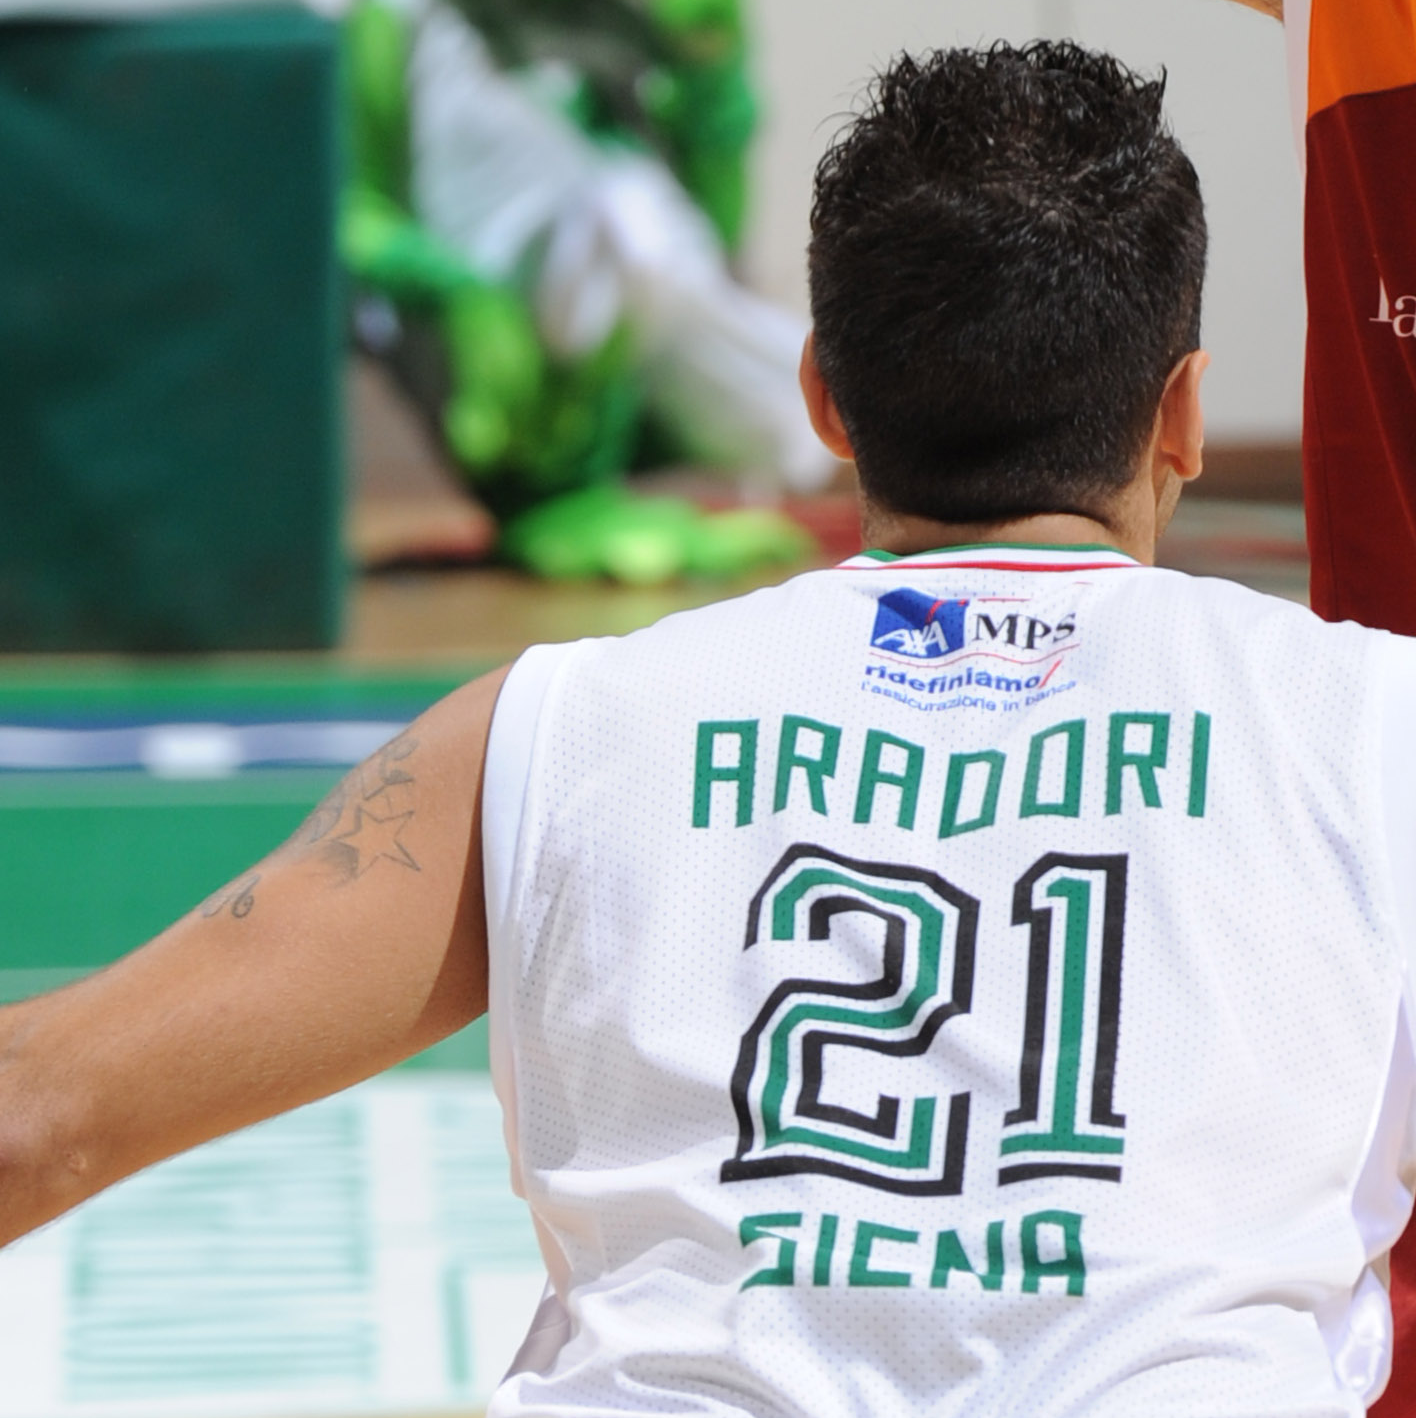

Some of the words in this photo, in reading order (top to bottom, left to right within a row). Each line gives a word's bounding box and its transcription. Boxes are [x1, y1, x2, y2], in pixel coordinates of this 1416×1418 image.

[873, 619, 950, 658] AXA
[970, 611, 1077, 651] MPS
[860, 679, 997, 712] l'assicurazione
[1002, 699, 1020, 713] in
[1024, 678, 1077, 707] banca
[864, 664, 1042, 695] ridefiniamo
[690, 711, 1212, 840] ARADORI
[718, 841, 1129, 1198] 21
